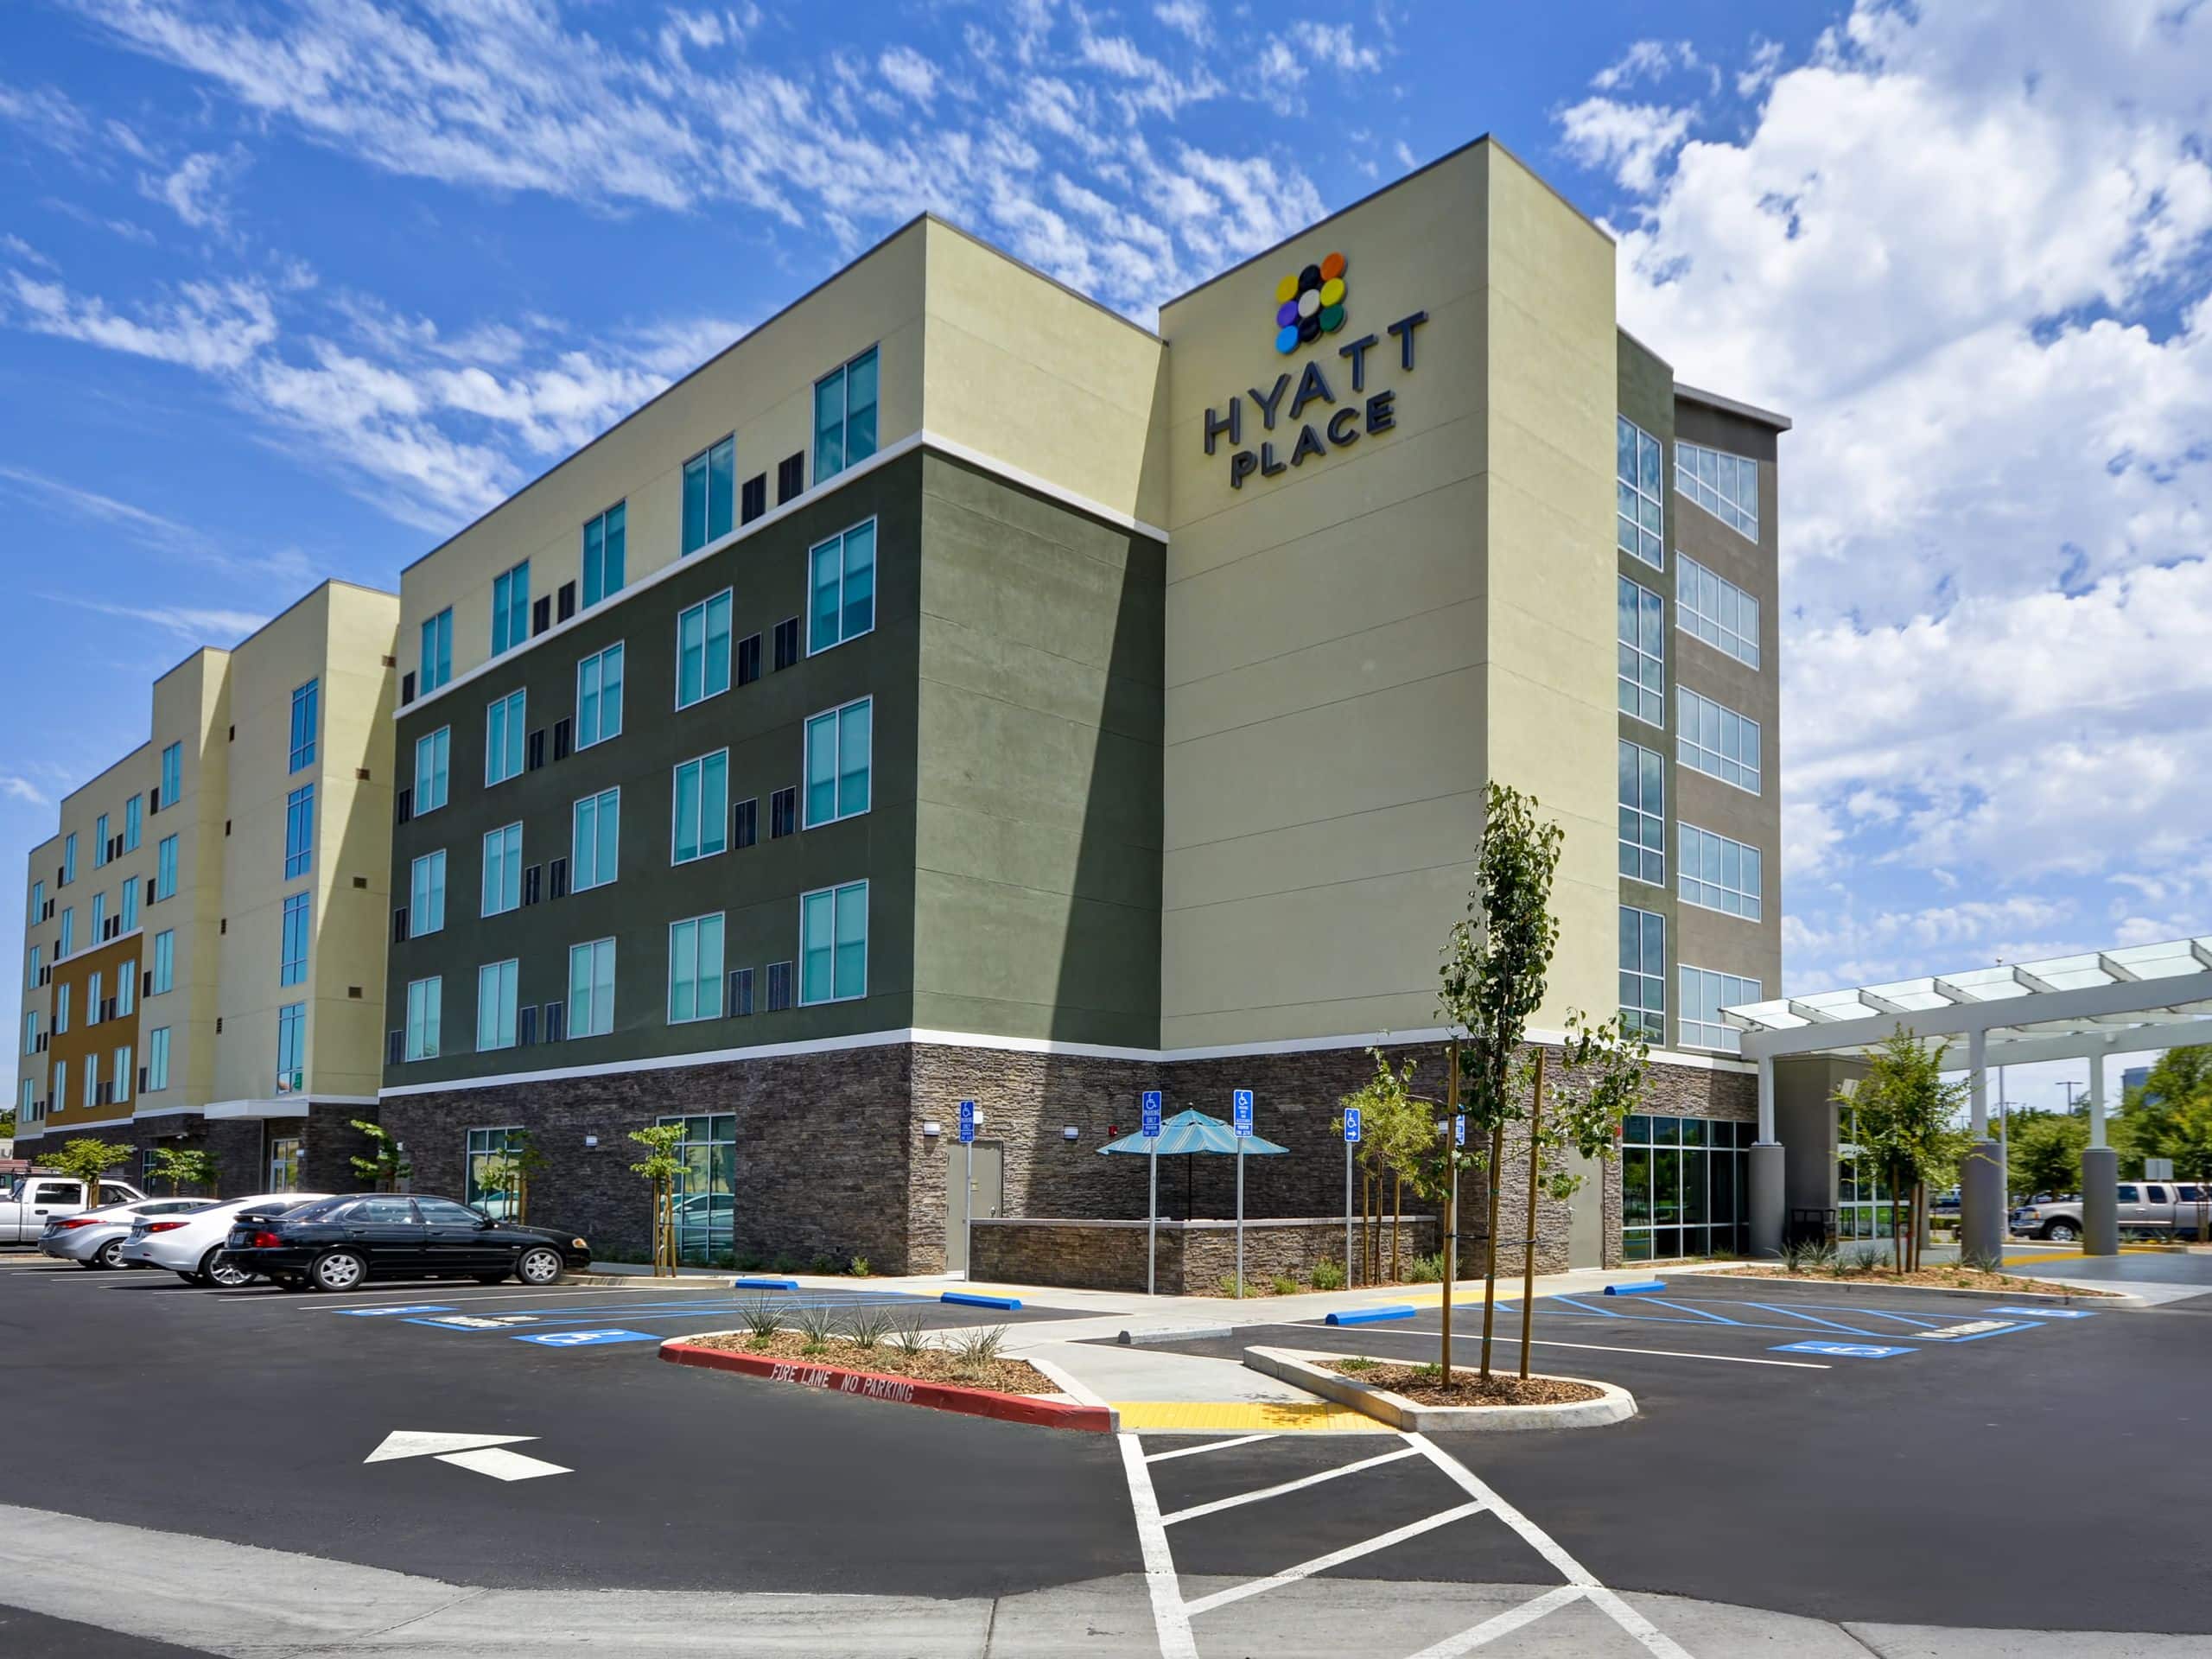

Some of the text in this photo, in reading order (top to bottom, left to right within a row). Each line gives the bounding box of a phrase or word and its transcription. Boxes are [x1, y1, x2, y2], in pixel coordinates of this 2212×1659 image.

[1205, 310, 1428, 455] HYATT
[1230, 390, 1396, 489] PLACE
[770, 1363, 913, 1402] FIRE LANE NO PARKING
